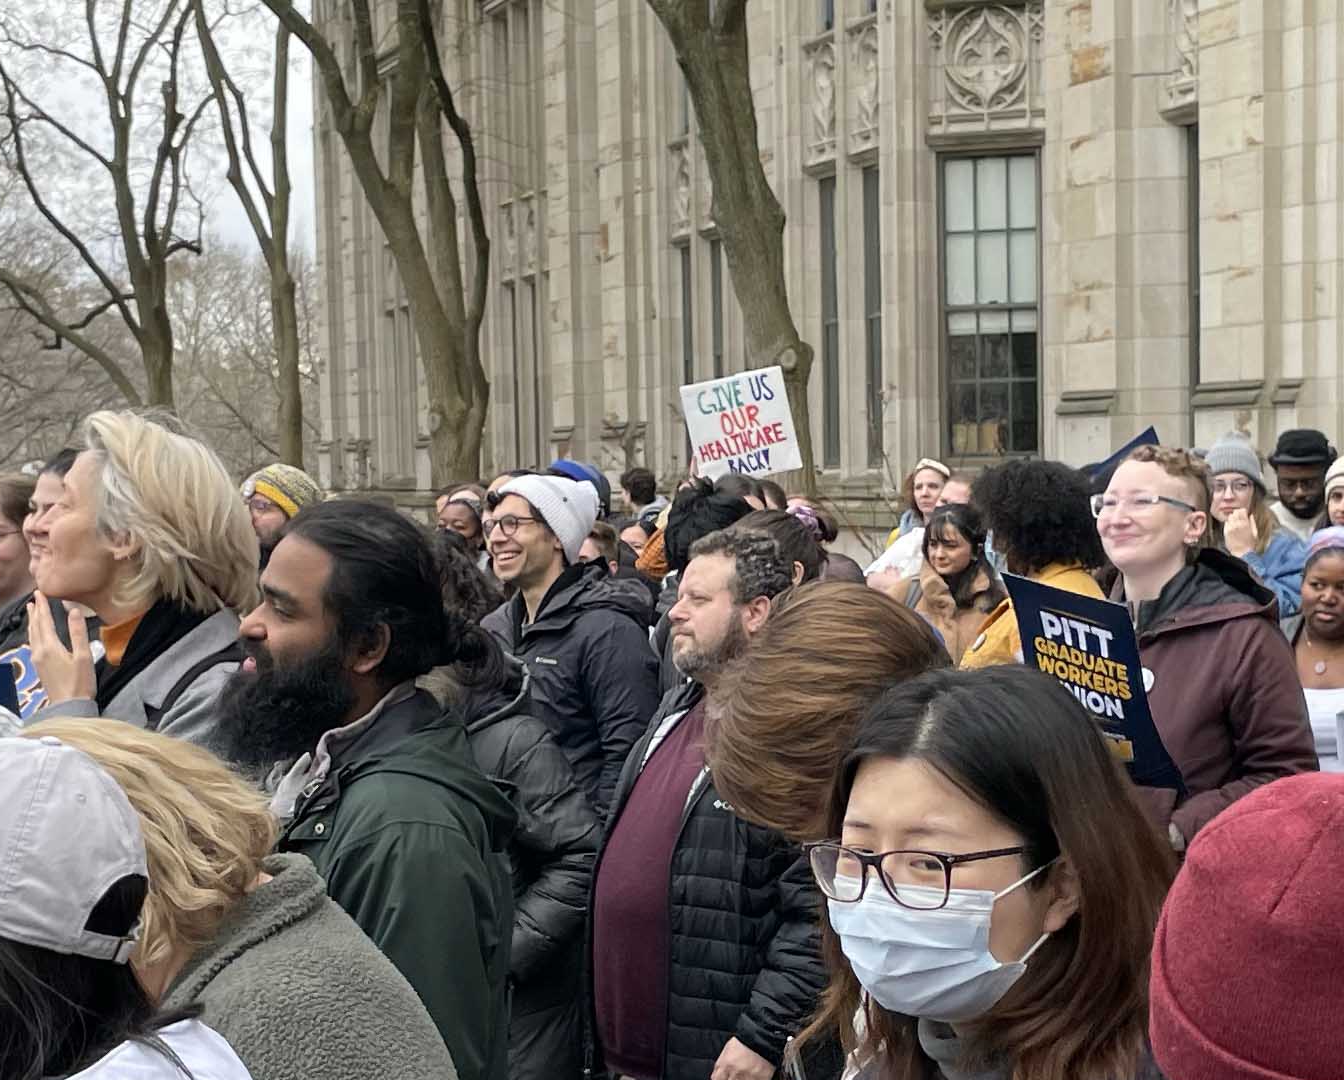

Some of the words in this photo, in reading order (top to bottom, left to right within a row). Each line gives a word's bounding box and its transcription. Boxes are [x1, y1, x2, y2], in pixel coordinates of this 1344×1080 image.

[697, 380, 744, 415] GIVE
[748, 374, 774, 401] US
[720, 404, 761, 436] OUR
[698, 422, 787, 463] HEALTHCARE
[728, 448, 772, 474] BACK!
[1039, 610, 1114, 658] PITT
[1033, 636, 1129, 682] GRADUATE
[1035, 653, 1133, 701] WORKERS
[1060, 680, 1125, 720] NION
